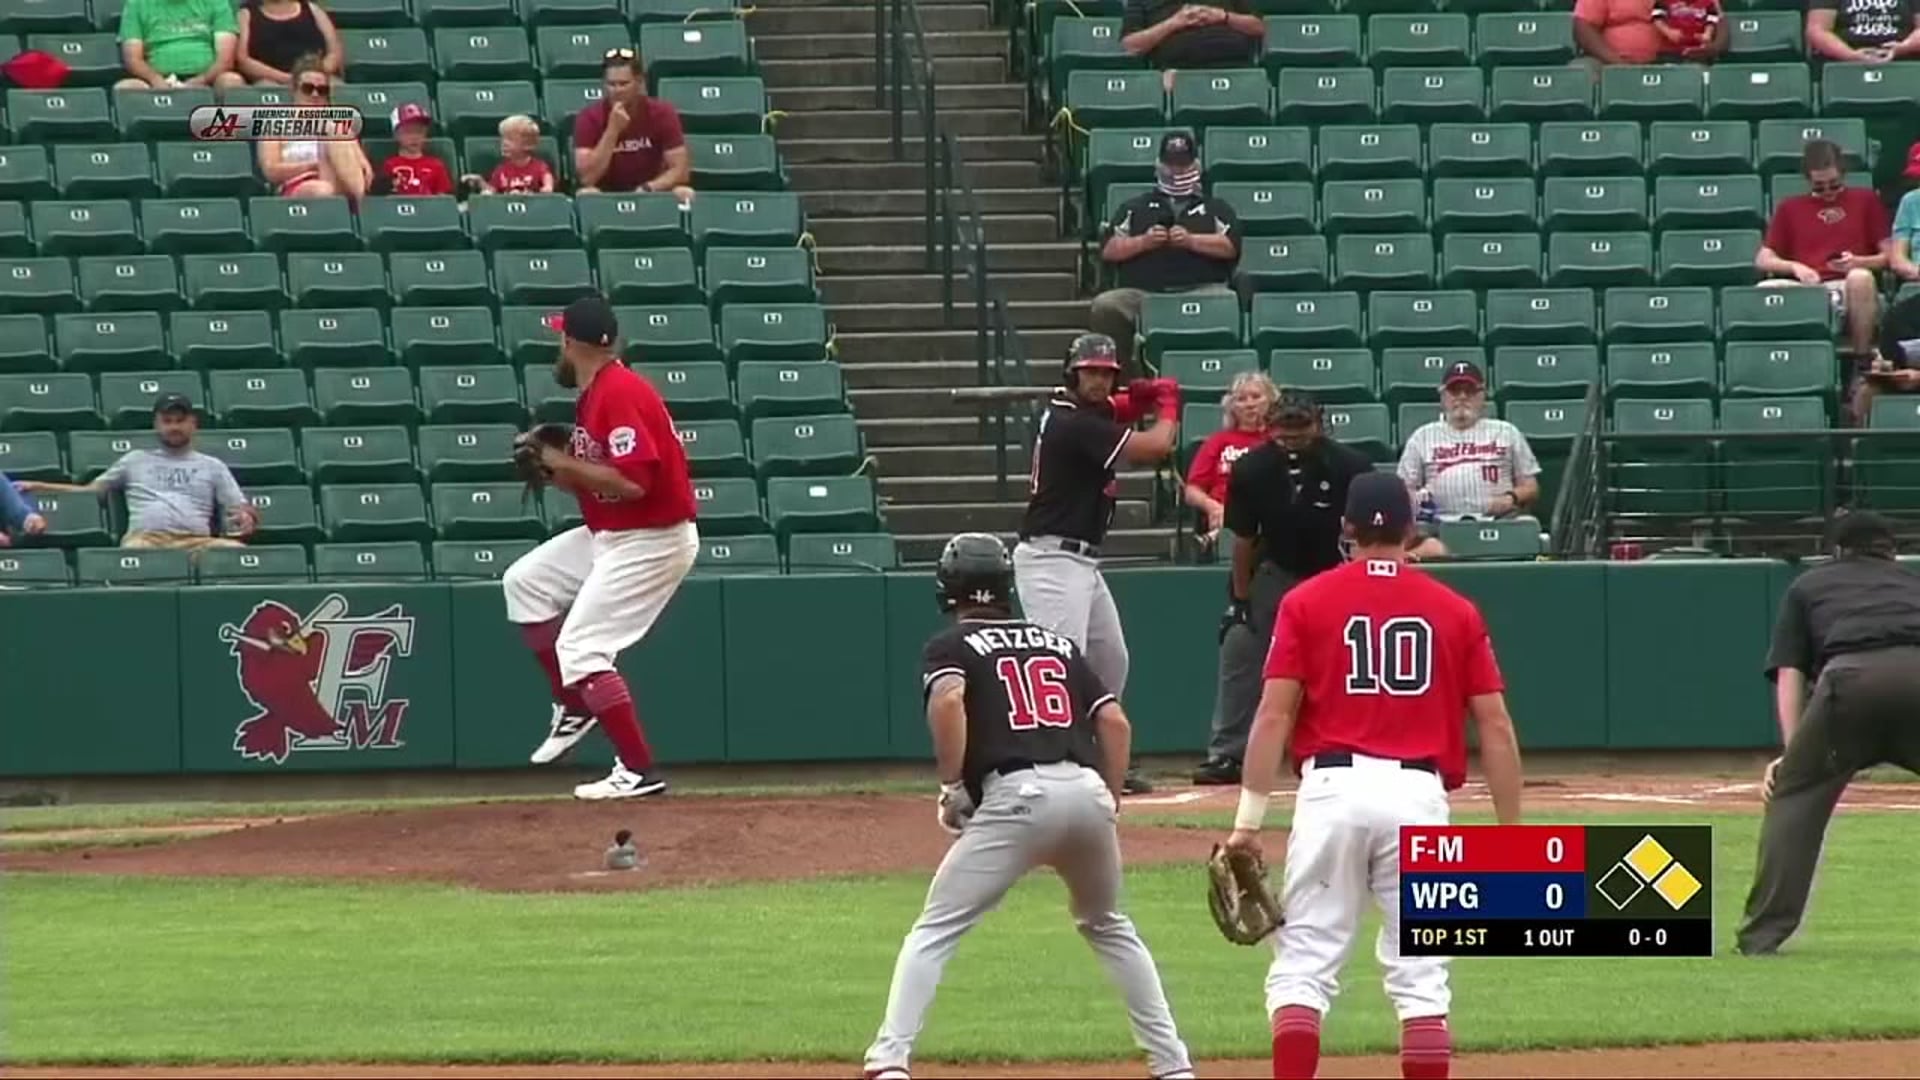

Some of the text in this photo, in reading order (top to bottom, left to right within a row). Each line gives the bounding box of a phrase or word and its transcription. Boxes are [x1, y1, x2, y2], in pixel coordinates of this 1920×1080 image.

[1456, 363, 1468, 374] T
[1433, 443, 1459, 460] Red
[1481, 465, 1498, 484] 10
[964, 627, 1073, 660] METZGER
[1344, 615, 1433, 696] 10
[996, 656, 1072, 730] 16
